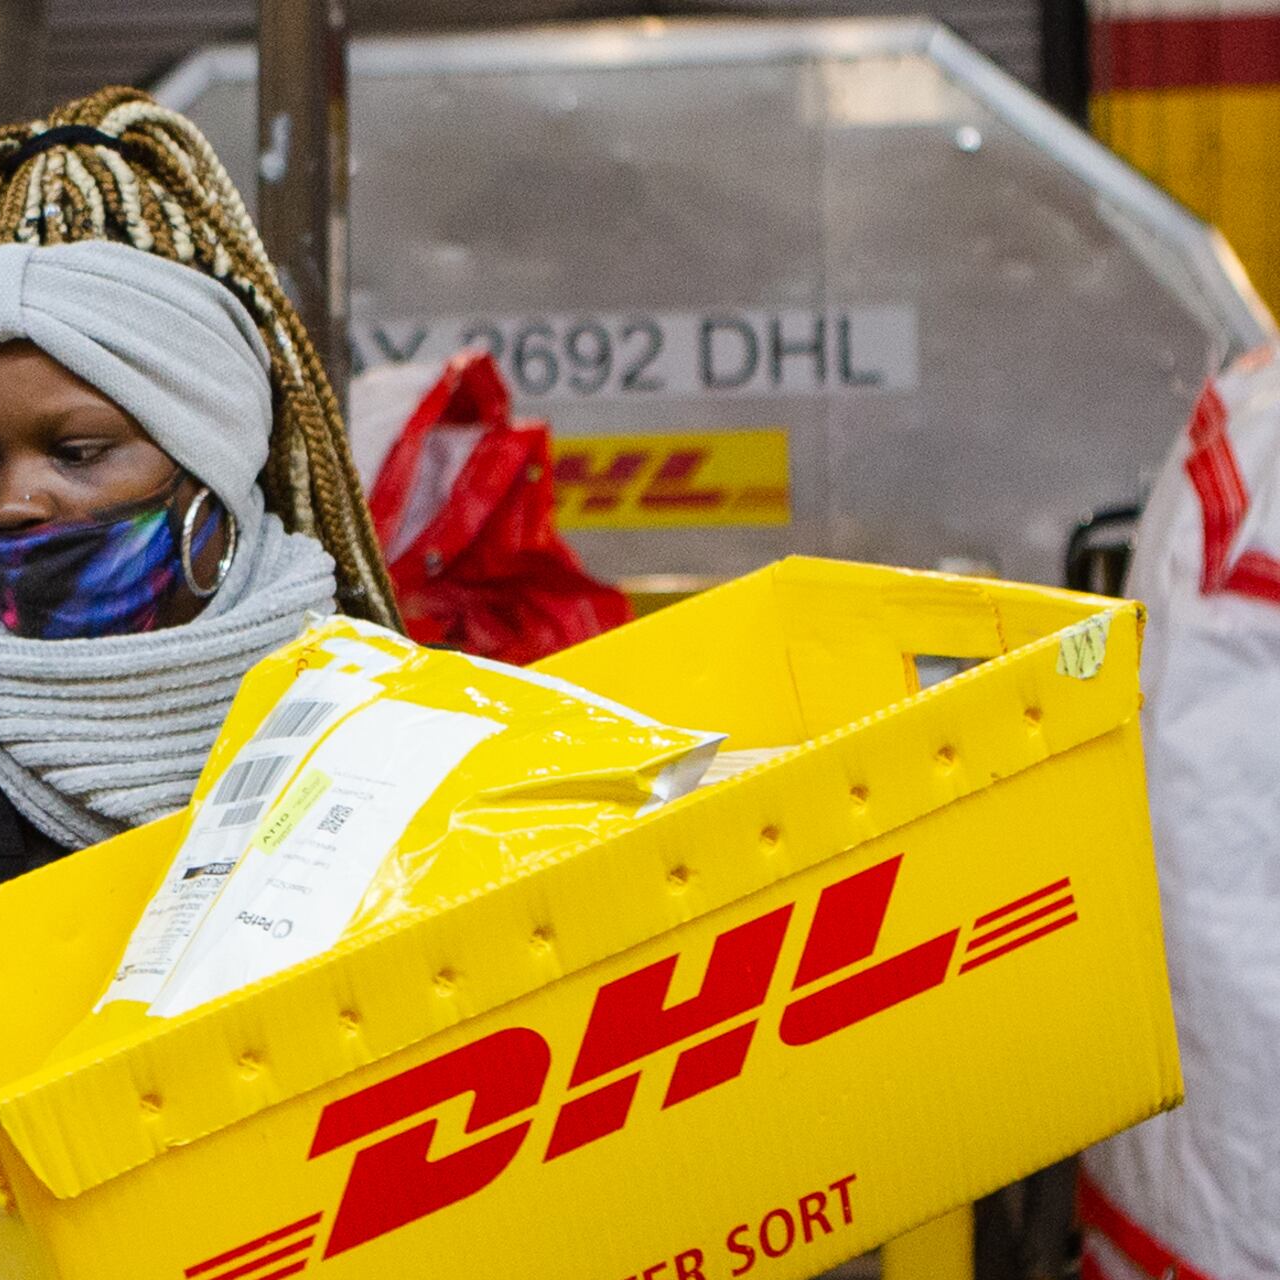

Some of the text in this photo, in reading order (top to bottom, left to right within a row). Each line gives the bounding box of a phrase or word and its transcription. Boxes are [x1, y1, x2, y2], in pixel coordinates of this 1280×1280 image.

[698, 312, 885, 389] DHL
[552, 450, 725, 512] HL
[307, 853, 958, 1261] DHL
[726, 1173, 859, 1277] SORT
